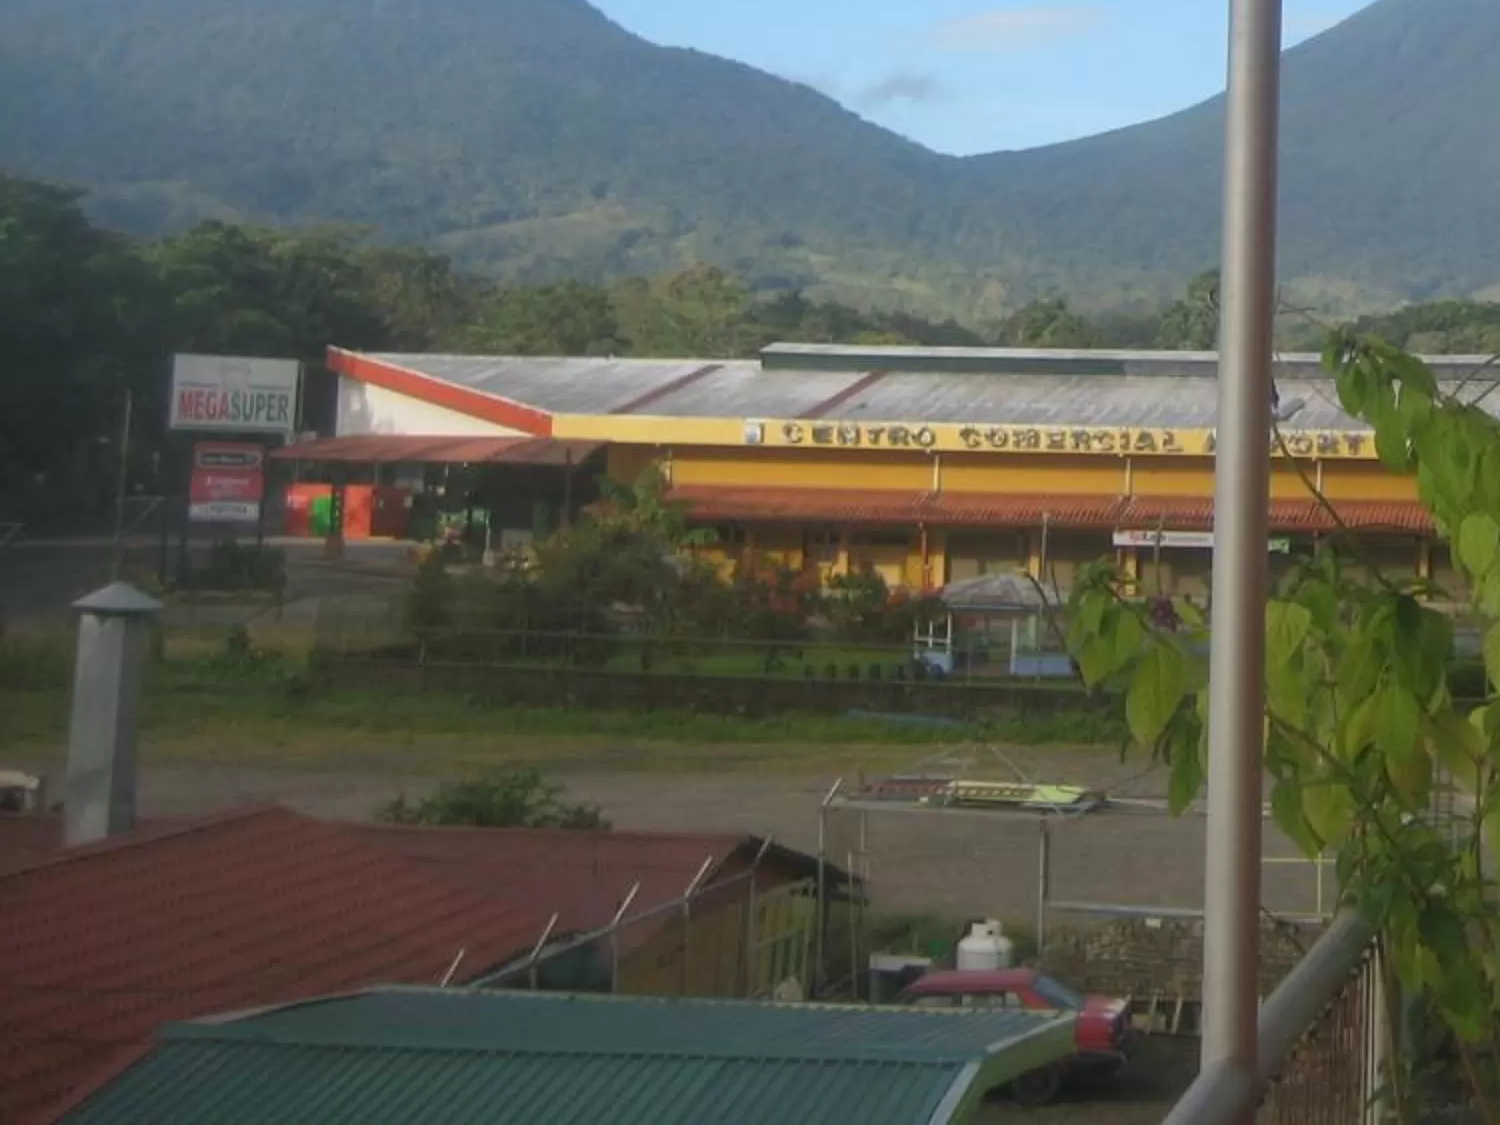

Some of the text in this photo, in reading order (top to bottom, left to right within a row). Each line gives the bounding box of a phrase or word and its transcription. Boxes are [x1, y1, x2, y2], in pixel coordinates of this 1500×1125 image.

[178, 388, 290, 422] MEGASUPER
[782, 422, 937, 448] CENTRO
[958, 426, 1185, 453] COMERCIAL
